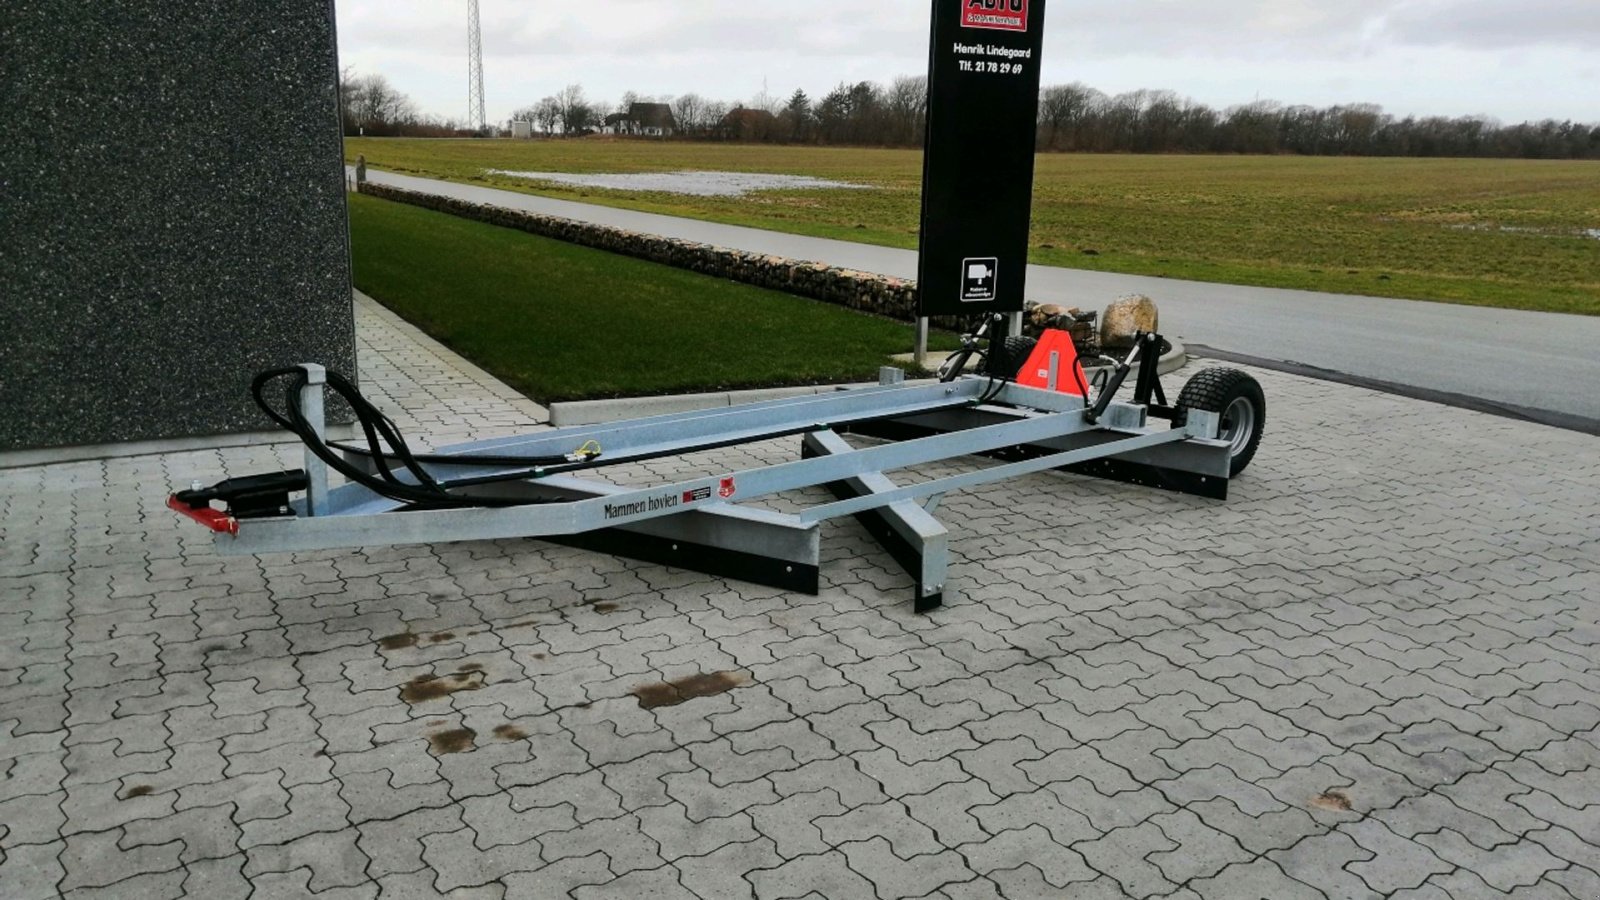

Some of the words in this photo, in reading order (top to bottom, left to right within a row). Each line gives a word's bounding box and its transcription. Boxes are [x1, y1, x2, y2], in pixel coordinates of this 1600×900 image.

[953, 43, 985, 55] Henrik
[986, 45, 1031, 59] Lindegaard
[975, 61, 985, 72] 21
[987, 62, 998, 73] 78
[1000, 63, 1010, 74] 29
[1012, 64, 1023, 75] 69
[604, 501, 646, 520] Mammen
